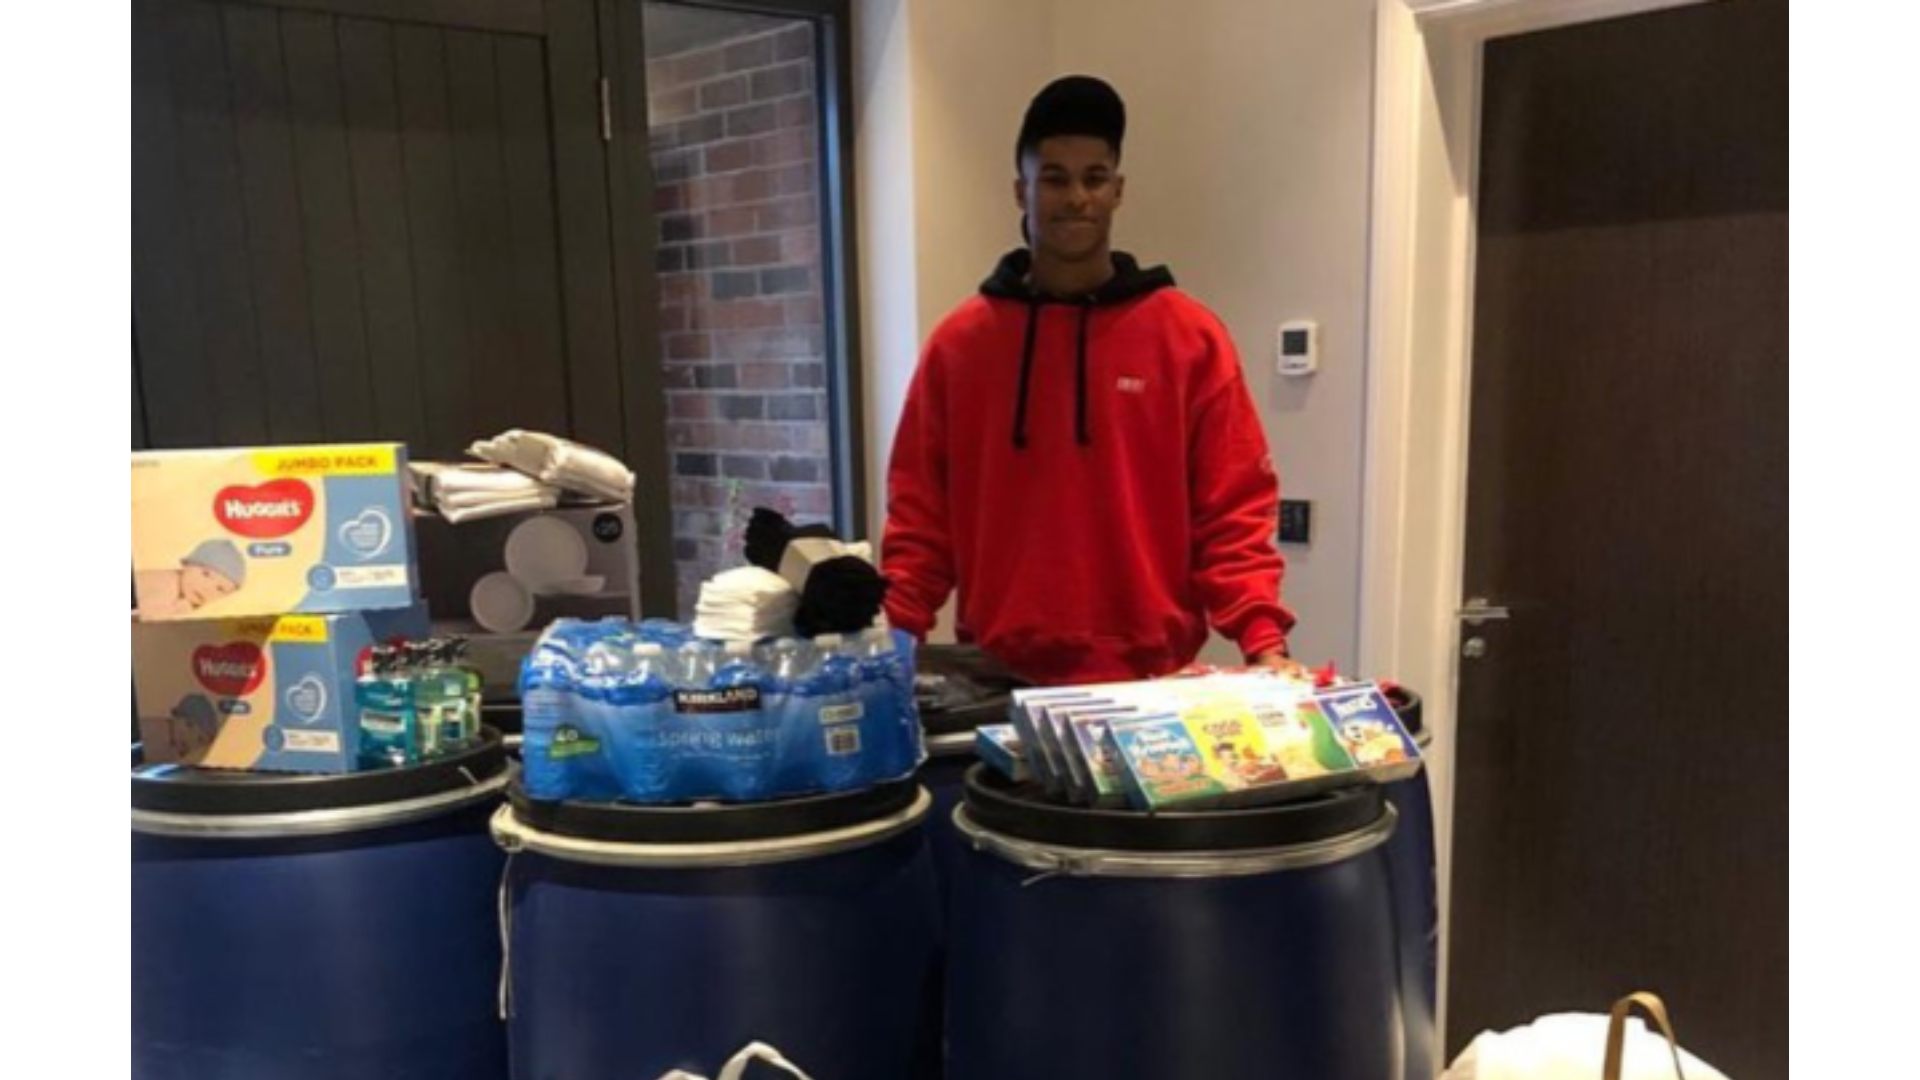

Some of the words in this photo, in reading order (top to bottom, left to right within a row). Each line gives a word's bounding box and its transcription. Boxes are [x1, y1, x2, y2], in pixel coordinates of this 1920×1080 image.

[277, 455, 330, 471] JUMBO
[334, 453, 377, 469] PACK
[677, 686, 758, 705] KIRKLAND
